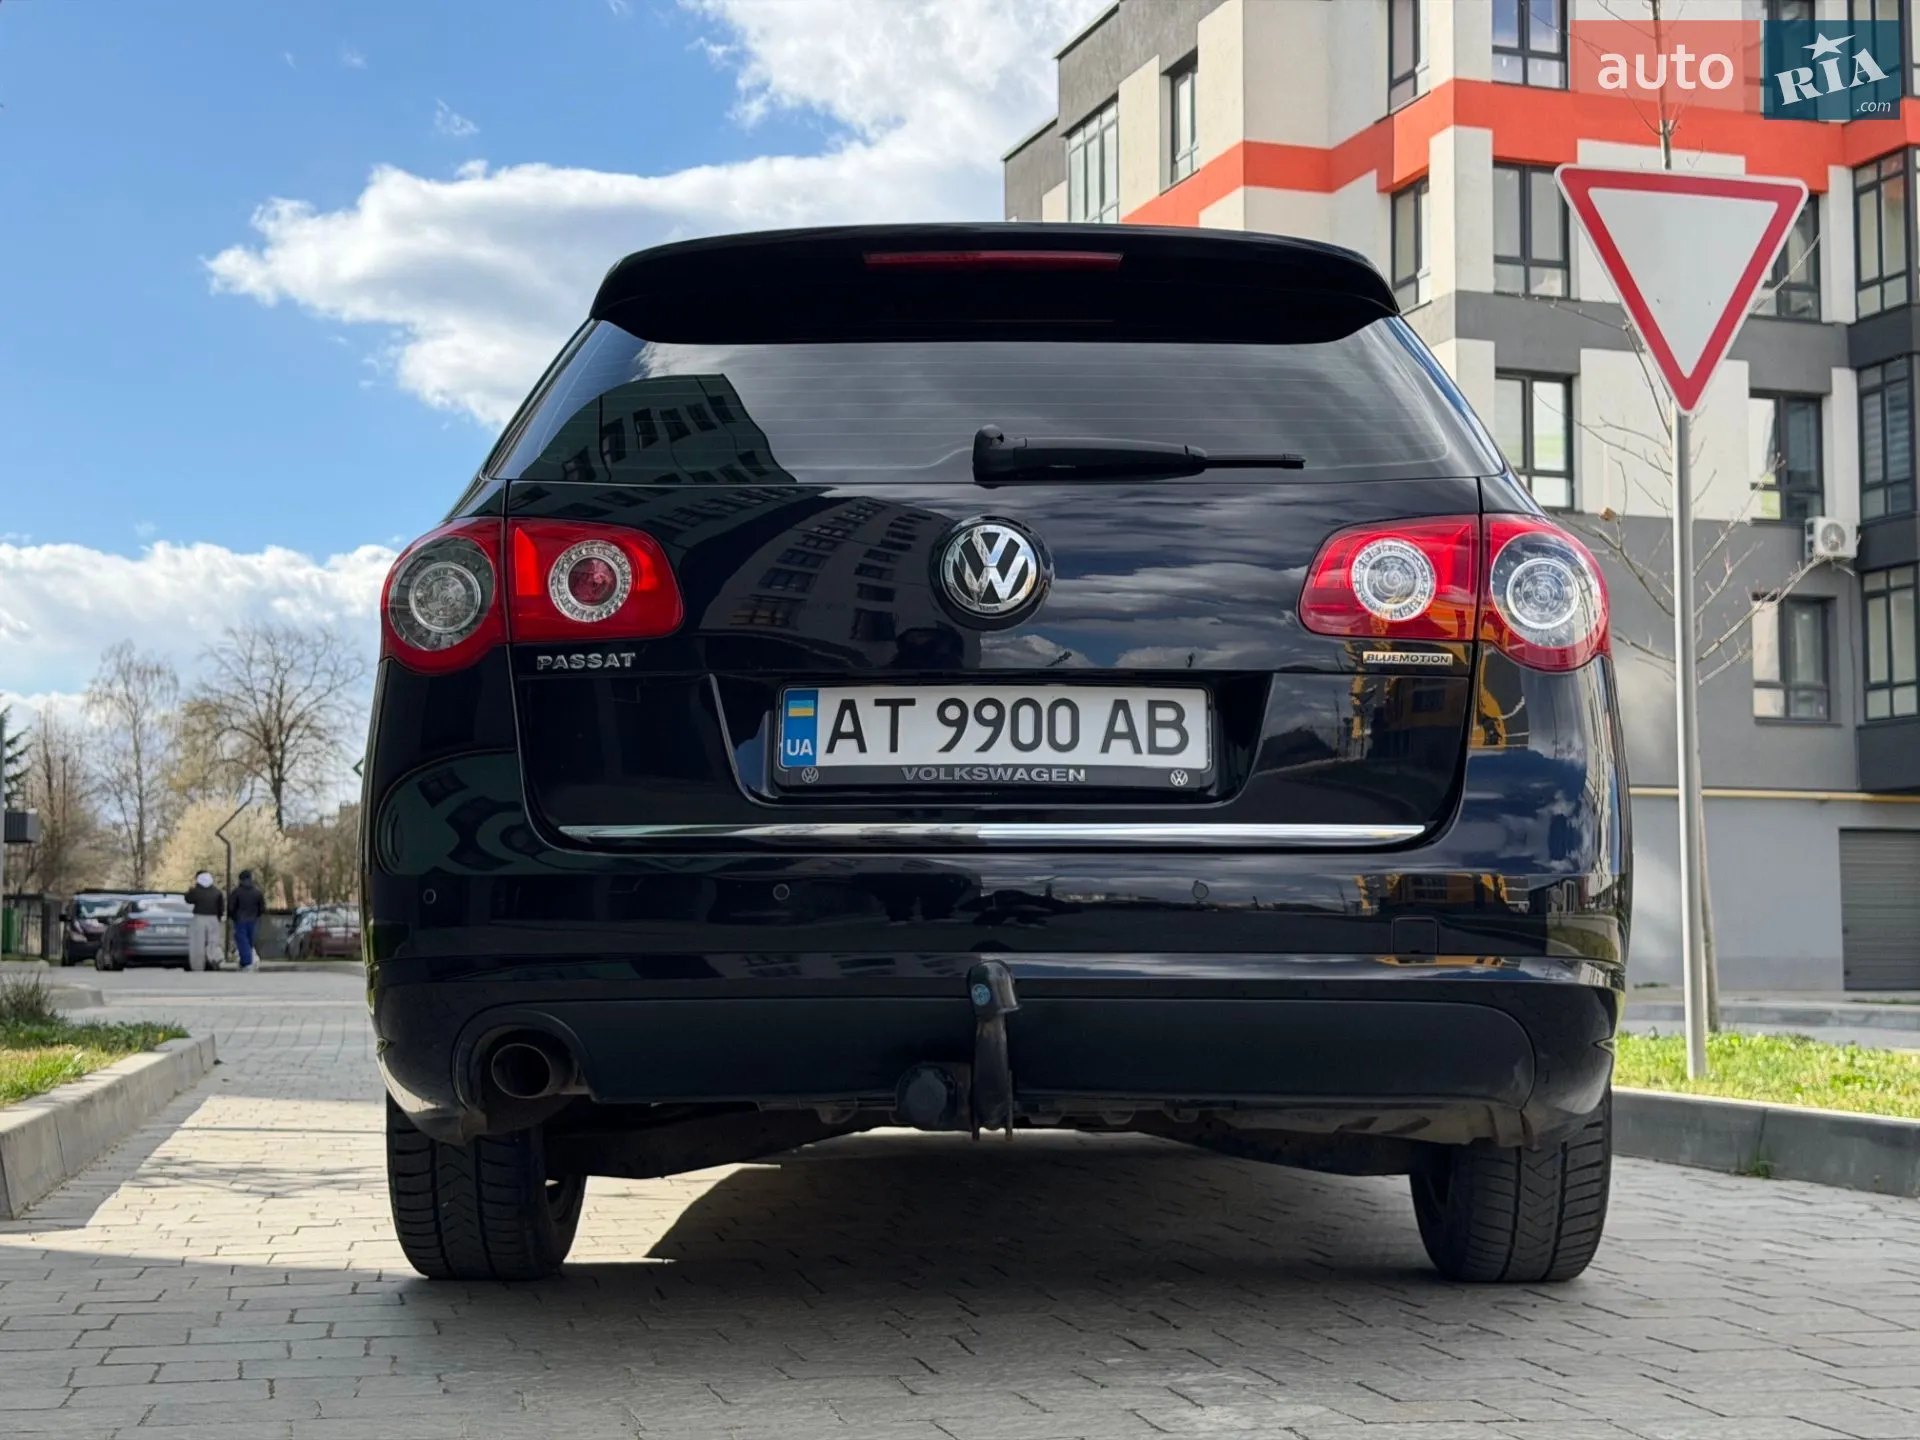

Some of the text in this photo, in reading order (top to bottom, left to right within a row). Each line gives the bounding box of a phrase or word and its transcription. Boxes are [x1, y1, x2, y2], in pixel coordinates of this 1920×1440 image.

[943, 524, 1037, 613] VW
[536, 651, 636, 671] PASSAT
[1365, 653, 1450, 664] BLUEMOTION
[825, 697, 1190, 755] AT 9900 AB
[786, 738, 814, 757] UA
[901, 766, 1086, 783] VOLKSWAGEN
